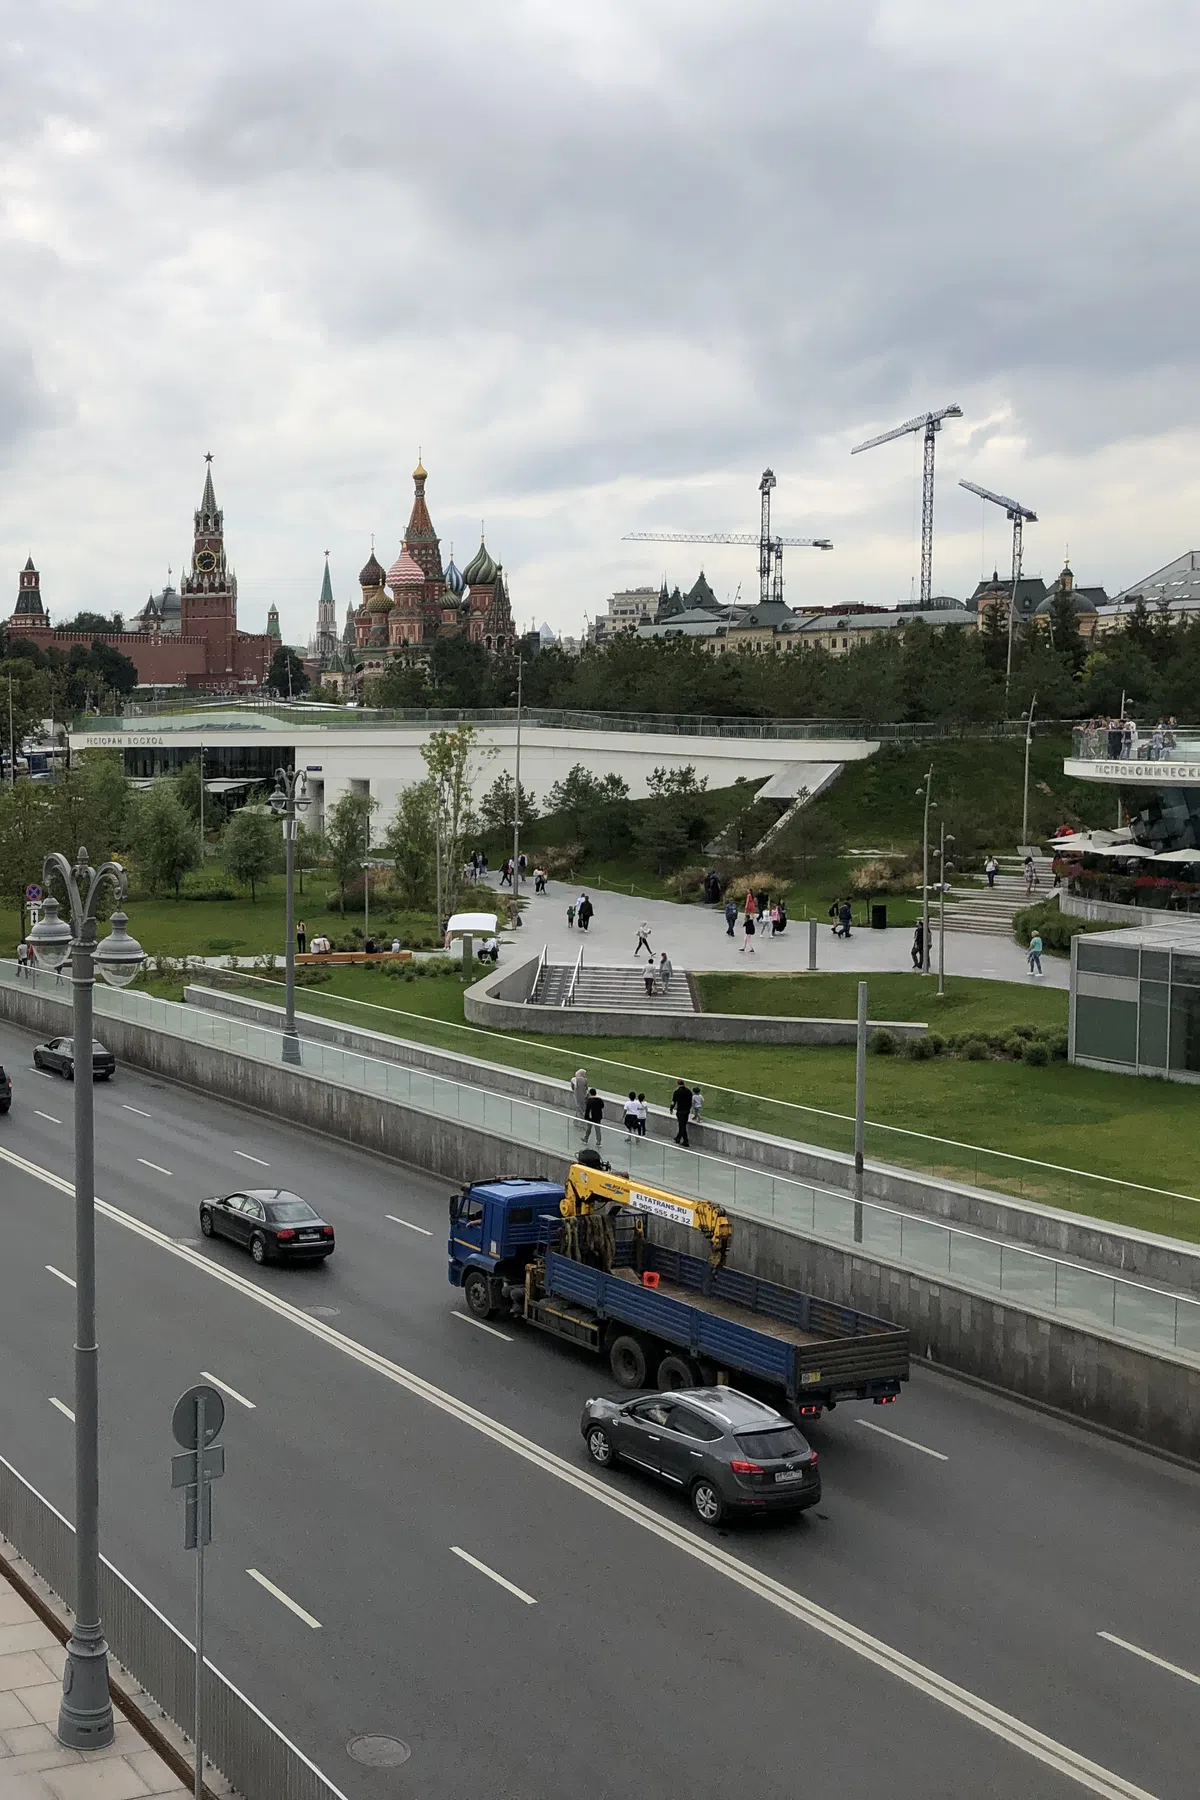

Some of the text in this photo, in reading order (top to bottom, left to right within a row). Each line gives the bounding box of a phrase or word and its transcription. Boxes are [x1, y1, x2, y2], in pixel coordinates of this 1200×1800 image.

[86, 737, 163, 745] РЕСТОРАН ВОСХОД
[636, 1193, 687, 1215] ELTATRANS.RU
[638, 1202, 653, 1213] 905
[654, 1207, 668, 1217] 555
[669, 1211, 680, 1220] 42
[680, 1215, 691, 1225] 32
